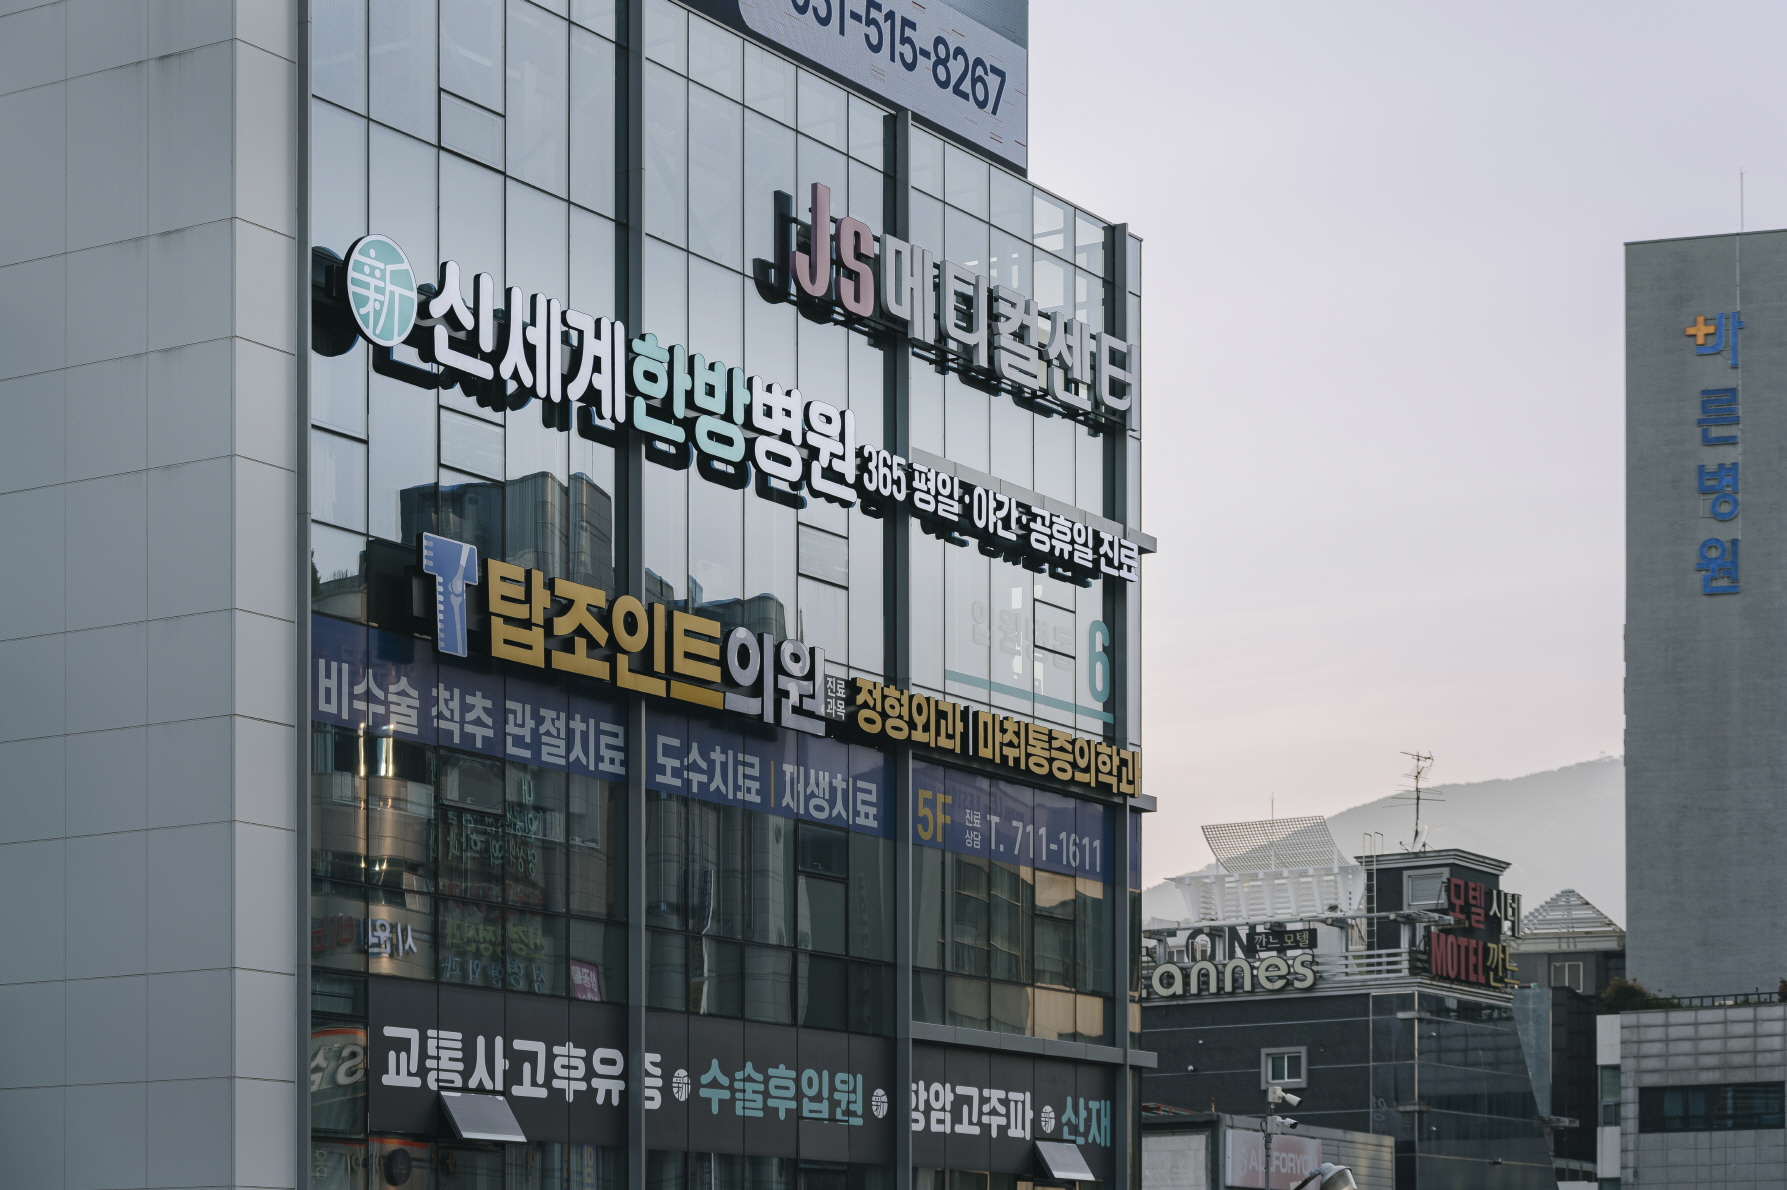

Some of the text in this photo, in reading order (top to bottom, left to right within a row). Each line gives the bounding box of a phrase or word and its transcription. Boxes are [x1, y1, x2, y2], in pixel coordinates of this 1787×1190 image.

[429, 259, 858, 502] 신세계한방병원
[863, 444, 906, 501] 365
[1100, 531, 1139, 583] 진료
[487, 557, 826, 737] 탑조인트의원
[1089, 619, 1110, 703] 6
[826, 677, 846, 698] 진료
[826, 697, 846, 721] 과목
[318, 658, 626, 776] 비수술 척추 관절치료
[855, 677, 1142, 798] 정형외과 마취통증의학과
[655, 734, 762, 804] 도수치료
[782, 763, 878, 828] 재생치료
[917, 789, 952, 843] 5F
[965, 809, 981, 828] 진료
[965, 829, 982, 849] 상담
[1012, 820, 1101, 873] 711-1611
[1448, 877, 1486, 929] 모텔
[1142, 952, 1317, 998] annes
[1431, 931, 1486, 984] MOTEL
[699, 1058, 863, 1126] 수술후입원
[1061, 1095, 1111, 1147] 산재
